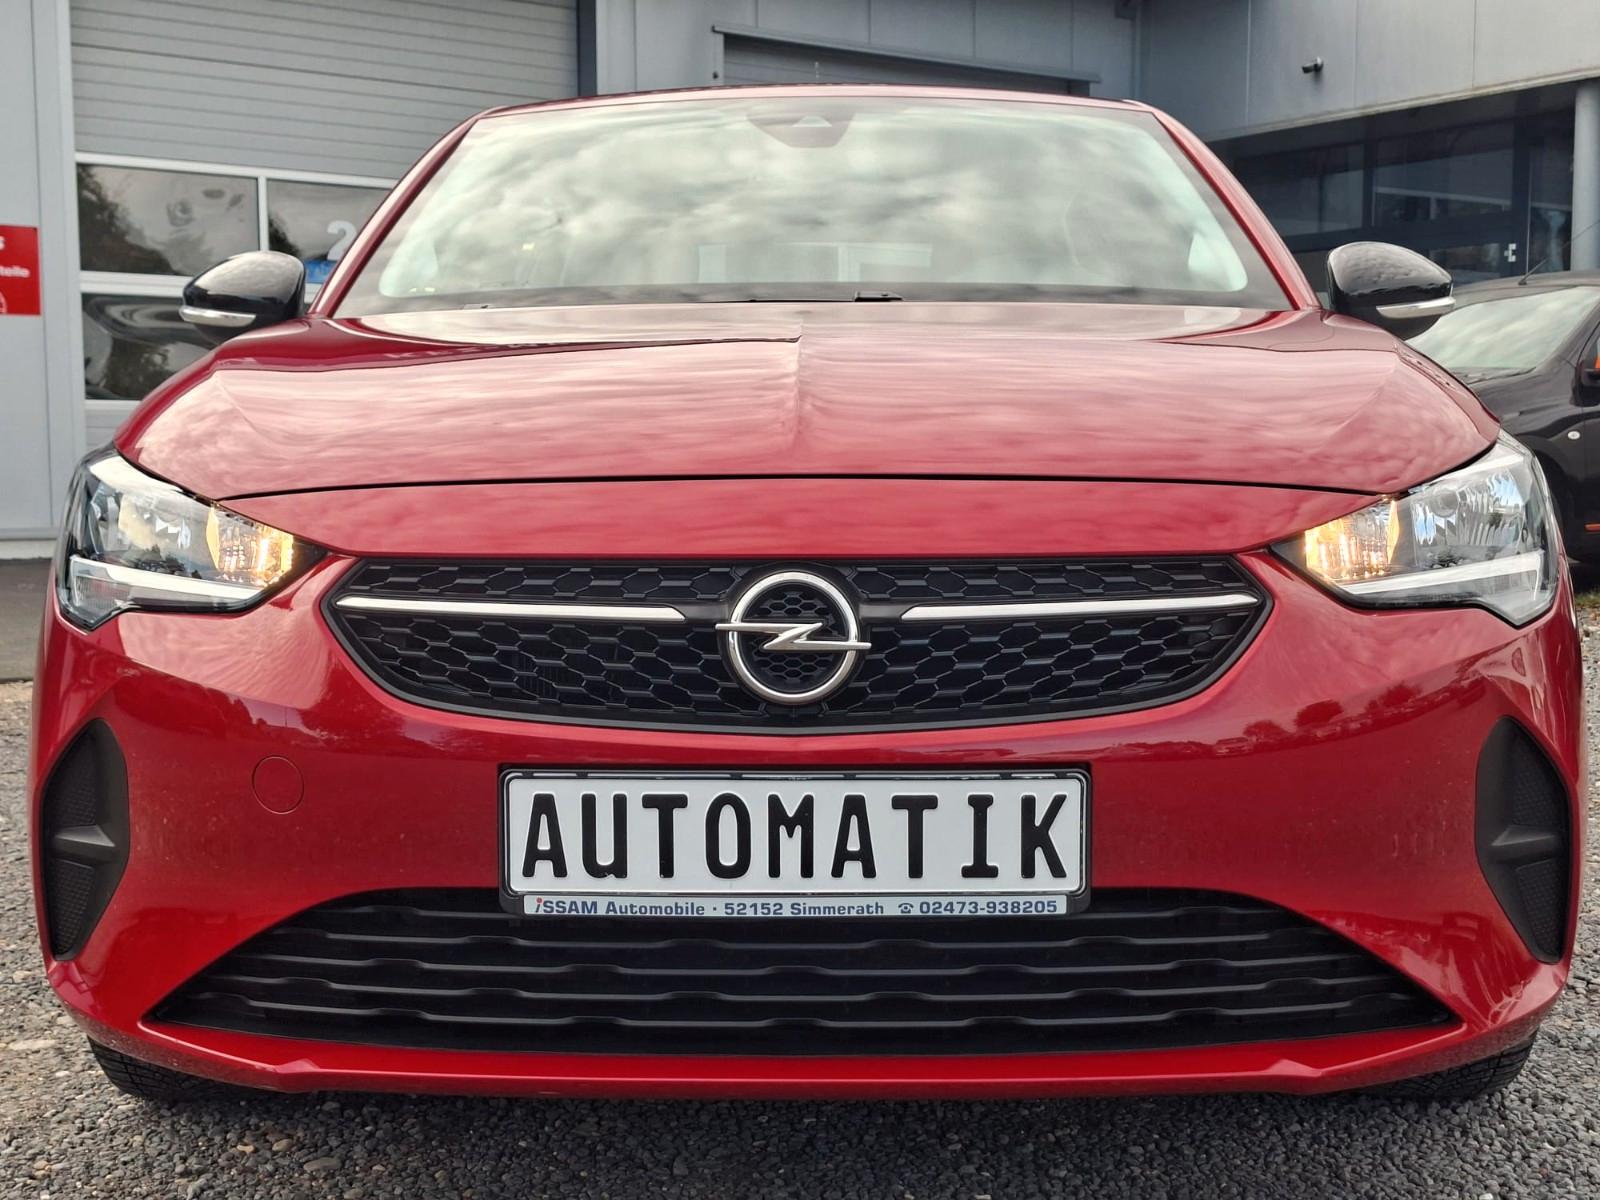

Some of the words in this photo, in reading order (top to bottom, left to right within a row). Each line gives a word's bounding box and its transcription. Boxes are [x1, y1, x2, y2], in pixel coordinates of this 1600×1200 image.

[327, 220, 357, 261] 2
[521, 792, 1068, 879] AUTOMATIK
[605, 901, 705, 915] Automobile
[724, 902, 784, 916] 52152
[790, 902, 884, 916] Simmerath
[919, 900, 1058, 915] 02473-938205
